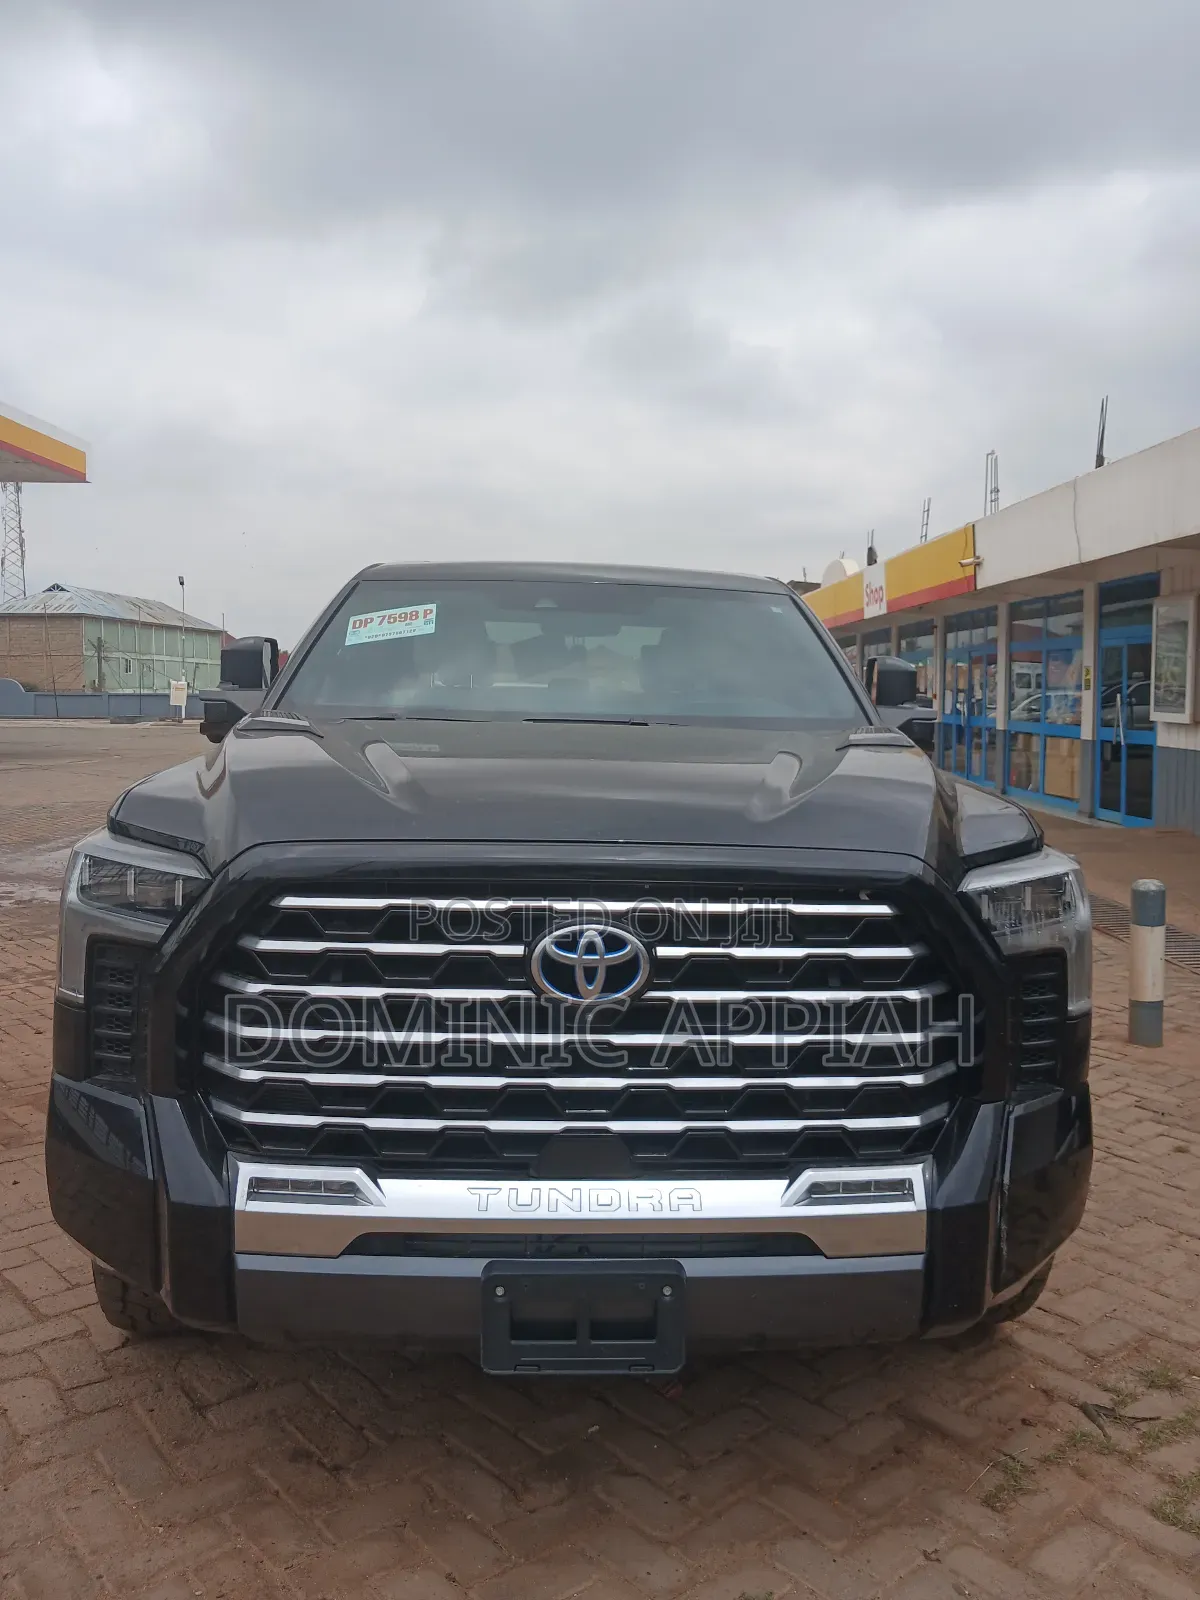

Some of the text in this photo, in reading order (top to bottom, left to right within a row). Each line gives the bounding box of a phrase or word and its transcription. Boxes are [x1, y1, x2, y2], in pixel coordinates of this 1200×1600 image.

[865, 582, 883, 611] Shop
[352, 617, 374, 629] DP
[377, 610, 419, 626] 7598
[423, 609, 433, 619] P
[467, 1186, 704, 1212] TUNDRA
